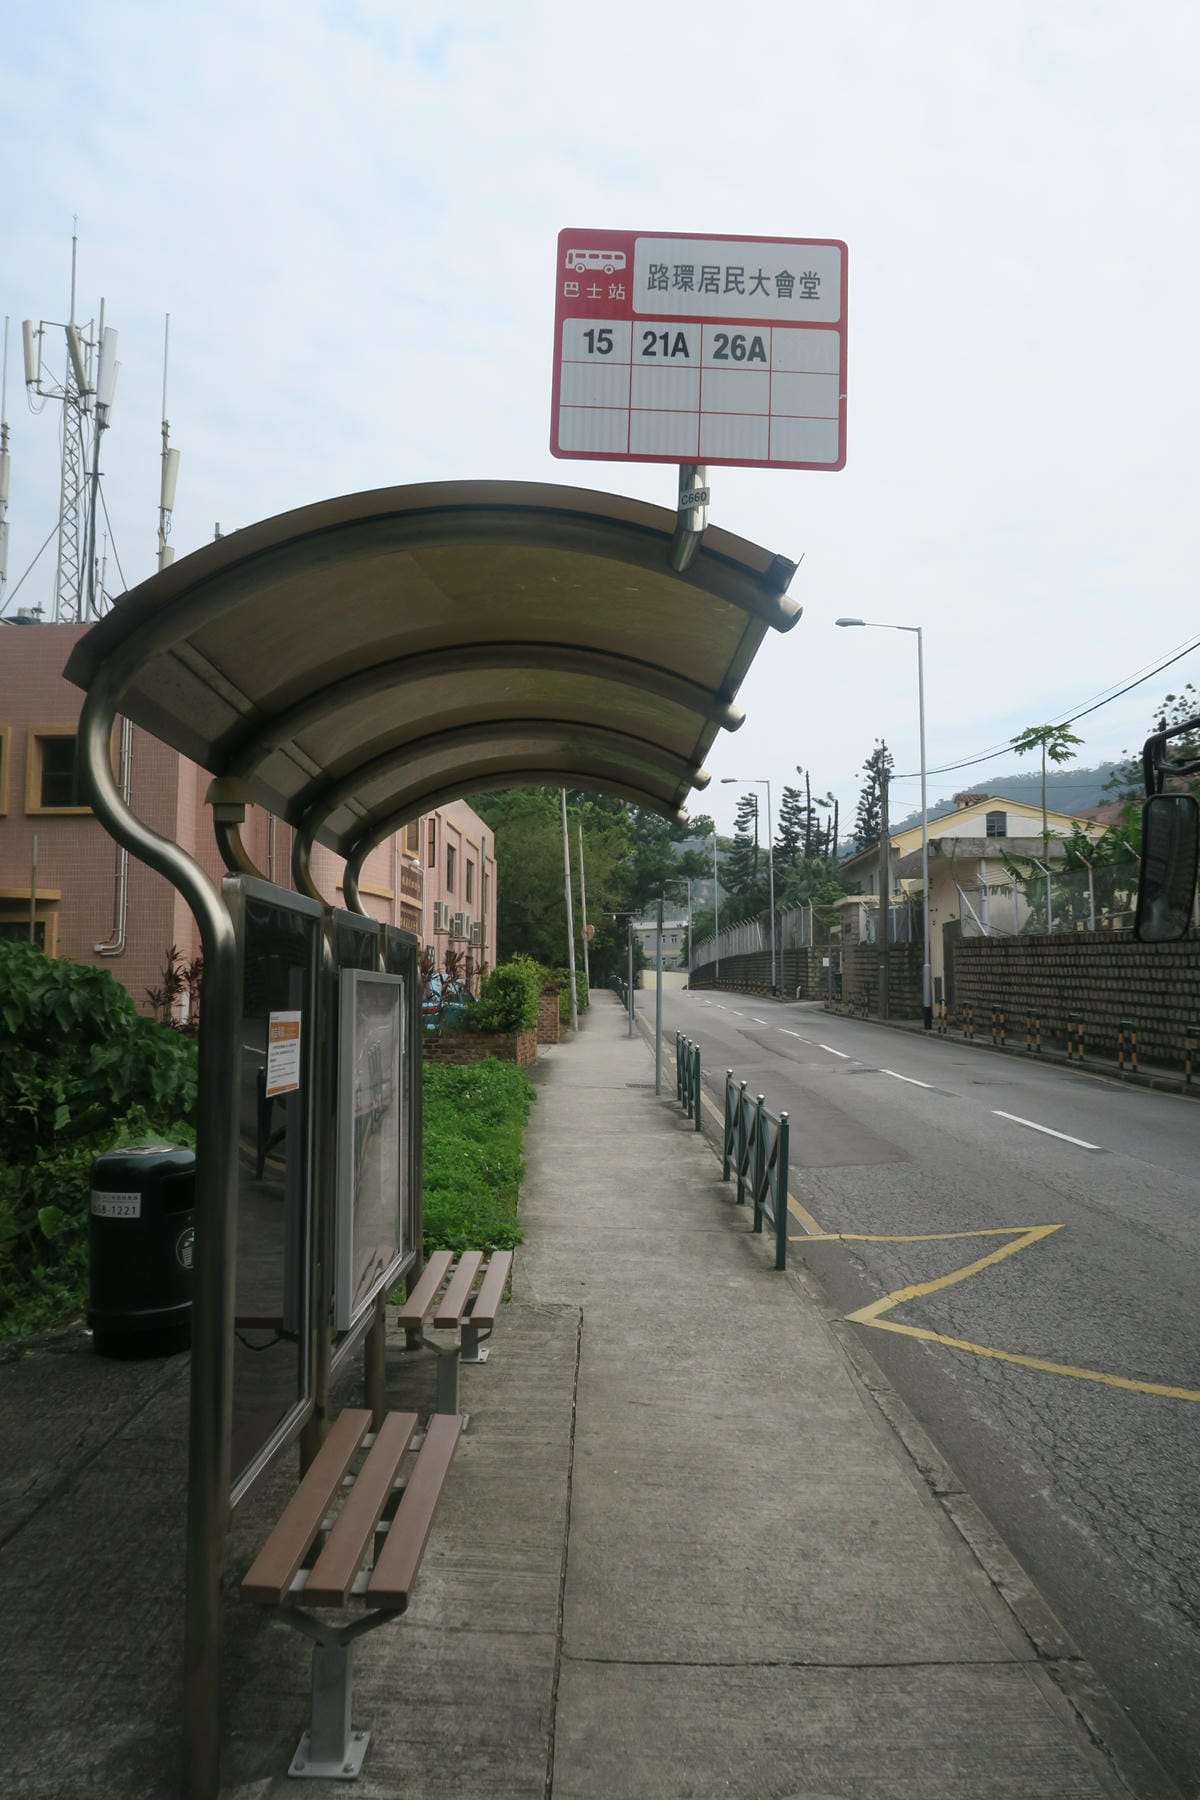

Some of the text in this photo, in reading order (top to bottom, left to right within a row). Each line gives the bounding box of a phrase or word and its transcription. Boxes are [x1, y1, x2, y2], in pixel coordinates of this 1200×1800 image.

[564, 281, 625, 300] 巴士站
[647, 263, 821, 300] 路環居民大會堂
[583, 328, 767, 362] 15 21A 26A
[681, 491, 707, 505] C660
